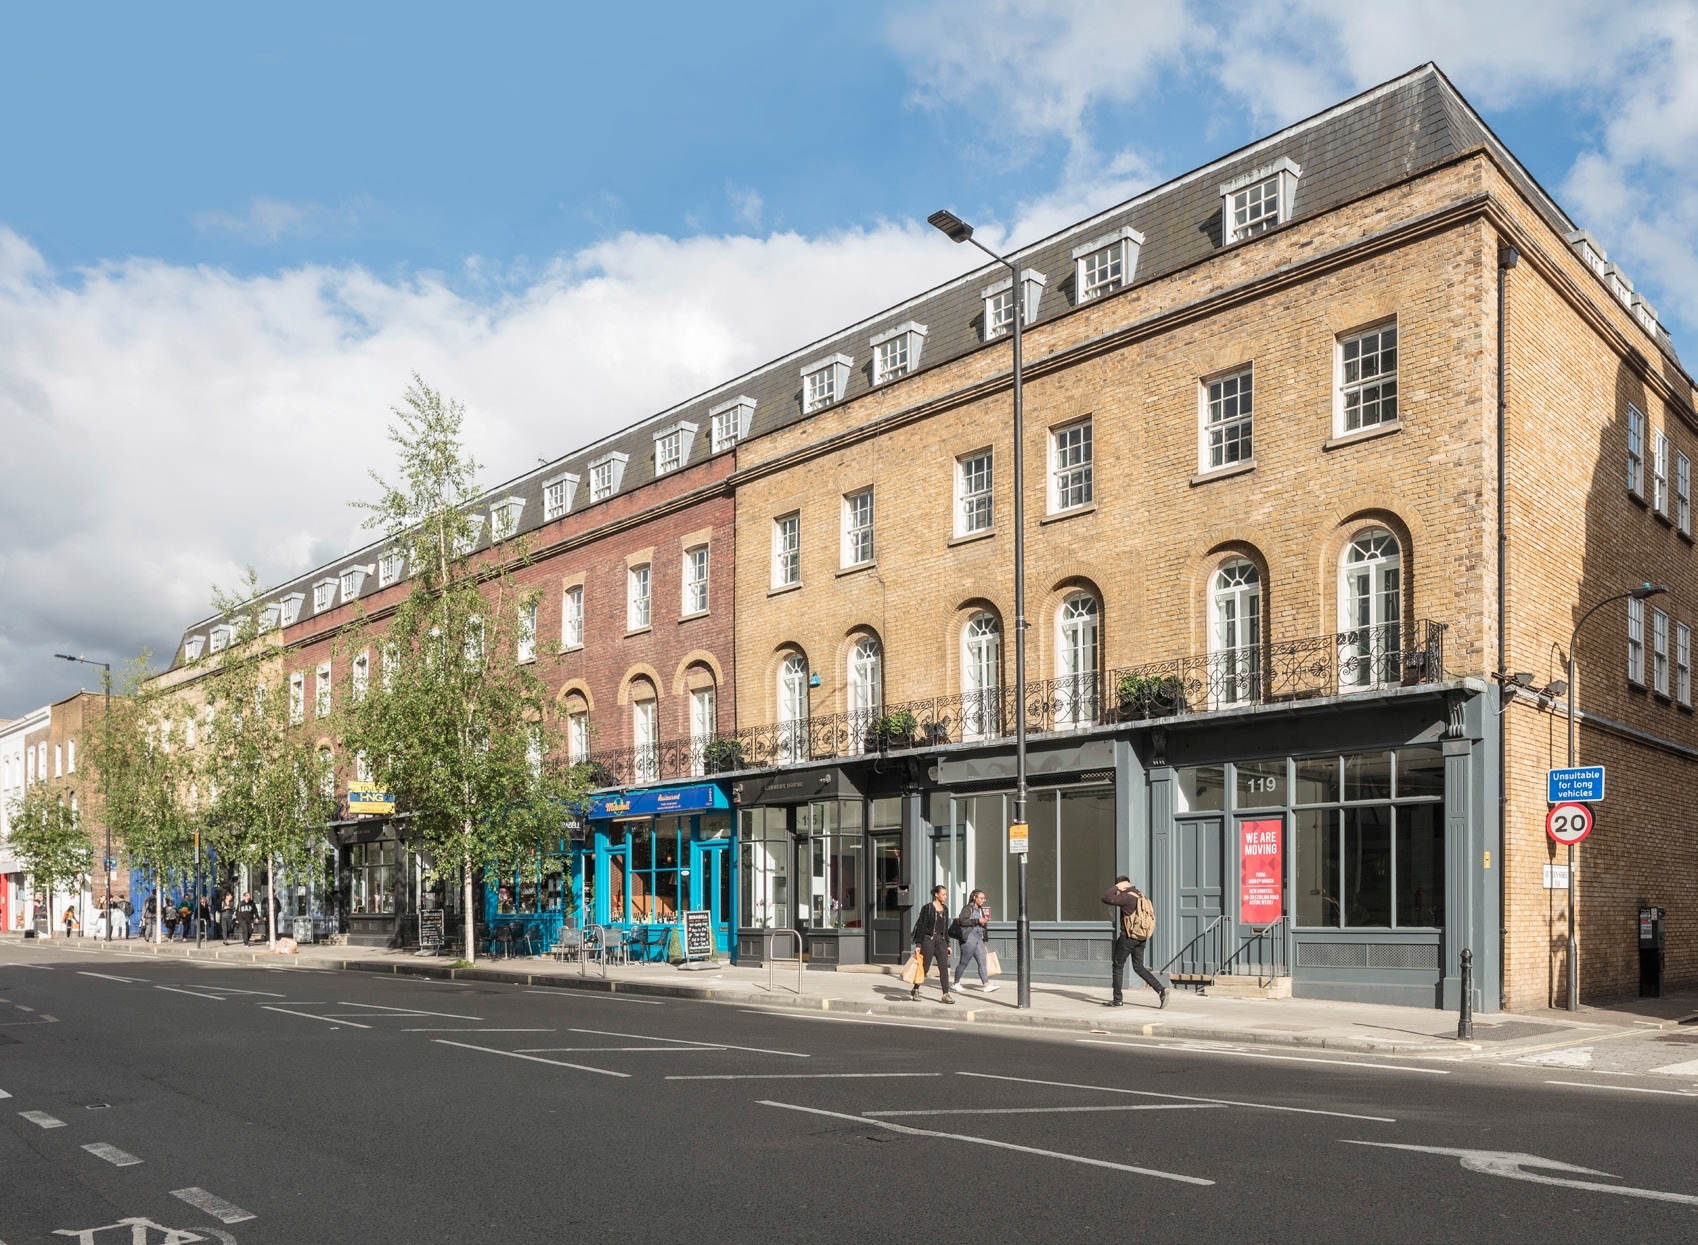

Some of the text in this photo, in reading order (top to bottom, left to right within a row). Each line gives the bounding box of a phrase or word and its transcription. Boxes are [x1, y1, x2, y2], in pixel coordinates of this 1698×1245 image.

[1553, 771, 1599, 780] Unsuitable
[1248, 776, 1277, 793] 119
[1558, 780, 1593, 789] for long
[360, 792, 384, 802] HNG
[802, 814, 817, 827] 15
[1554, 814, 1586, 833] 20
[1245, 831, 1276, 844] WE ARE
[1244, 843, 1277, 855] MOVING
